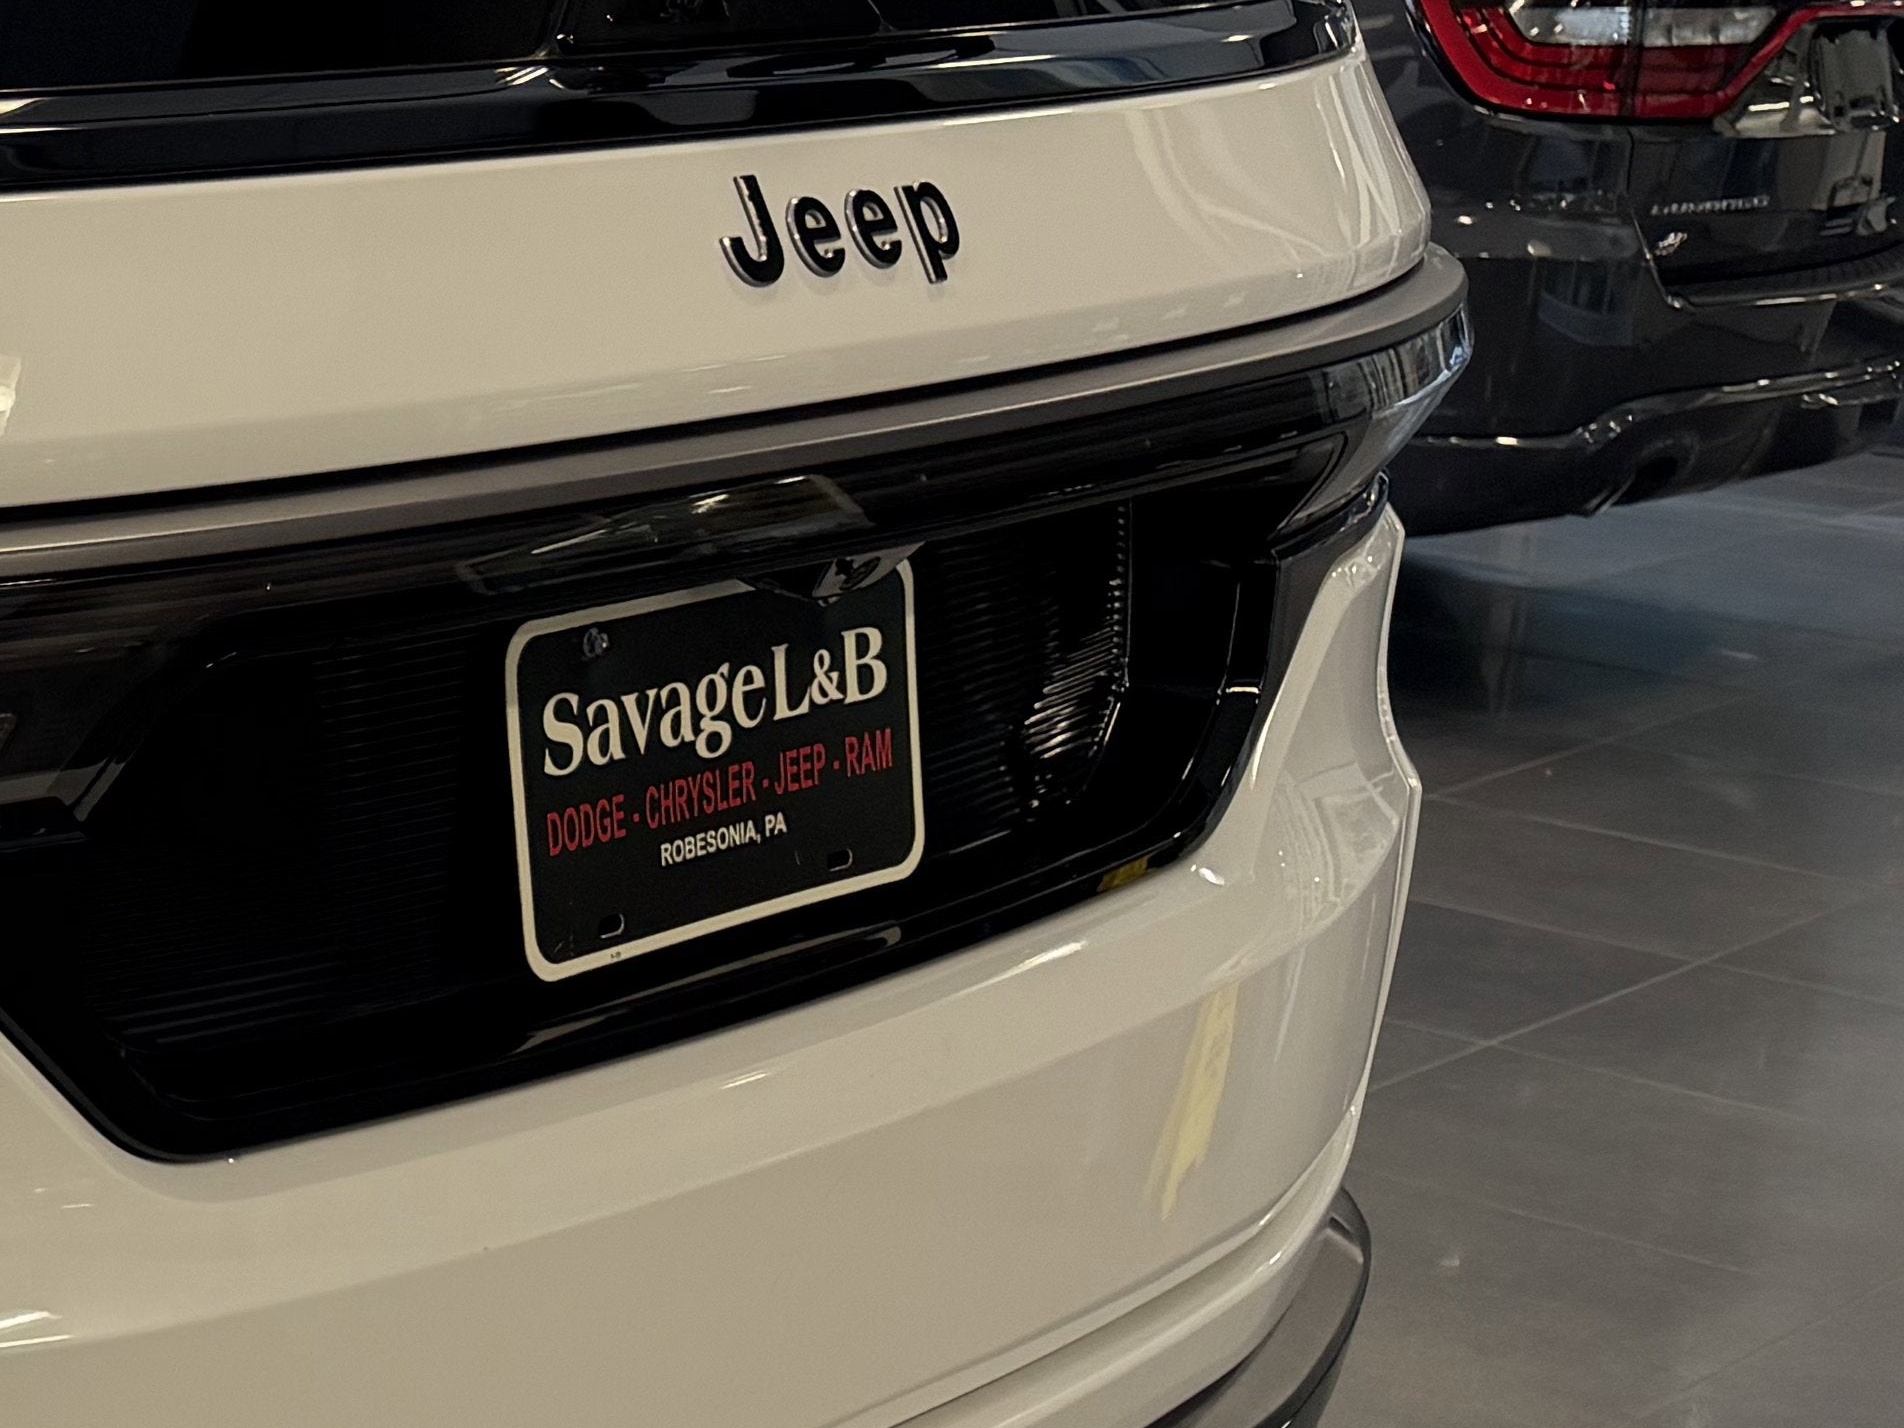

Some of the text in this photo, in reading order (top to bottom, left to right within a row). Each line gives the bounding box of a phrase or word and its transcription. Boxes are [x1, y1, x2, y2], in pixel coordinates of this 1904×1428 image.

[719, 174, 960, 287] Jeep
[546, 794, 628, 857] DODGE
[645, 760, 757, 830] CHRYSLER
[773, 742, 827, 797] JEEP
[845, 727, 893, 775] RAM
[659, 810, 788, 868] ROBESONIA, PA
